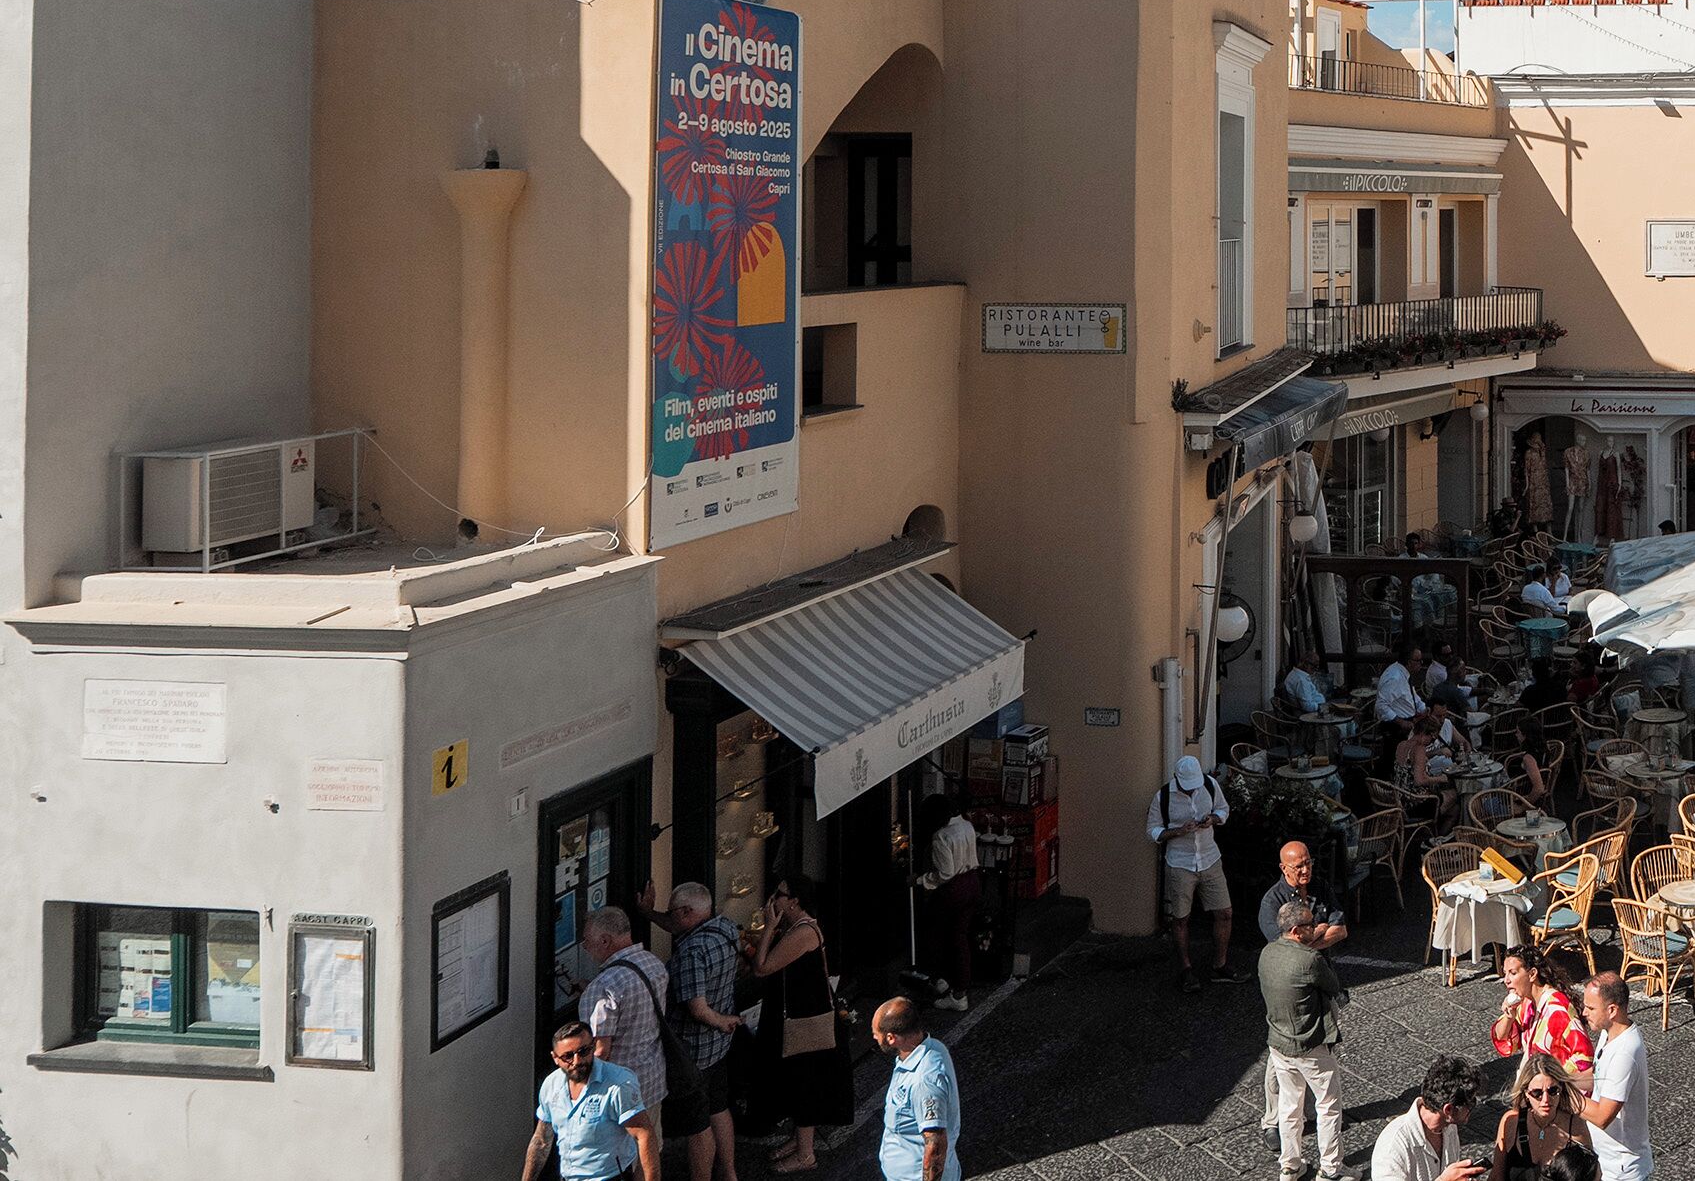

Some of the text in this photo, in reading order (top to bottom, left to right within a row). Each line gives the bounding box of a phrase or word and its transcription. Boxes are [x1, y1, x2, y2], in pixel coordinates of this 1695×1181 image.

[699, 23, 793, 72] Cinema
[670, 63, 792, 109] in Certosa
[711, 118, 756, 137] agosto
[759, 120, 791, 139] 2025
[725, 148, 791, 163] Chiostro Grande
[691, 161, 791, 178] Certosa di San Giacomo
[768, 183, 791, 196] Capri
[988, 309, 1096, 322] RISTORANTE
[1003, 324, 1081, 337] PULALLI
[1018, 338, 1065, 347] wine bar
[664, 382, 778, 418] Film, eventi e ospiti
[1571, 399, 1657, 413] La Parisienne
[664, 408, 777, 443] del cinema italiano
[112, 698, 199, 708] FRANCESCO SPADARO
[897, 697, 966, 749] Carthusia
